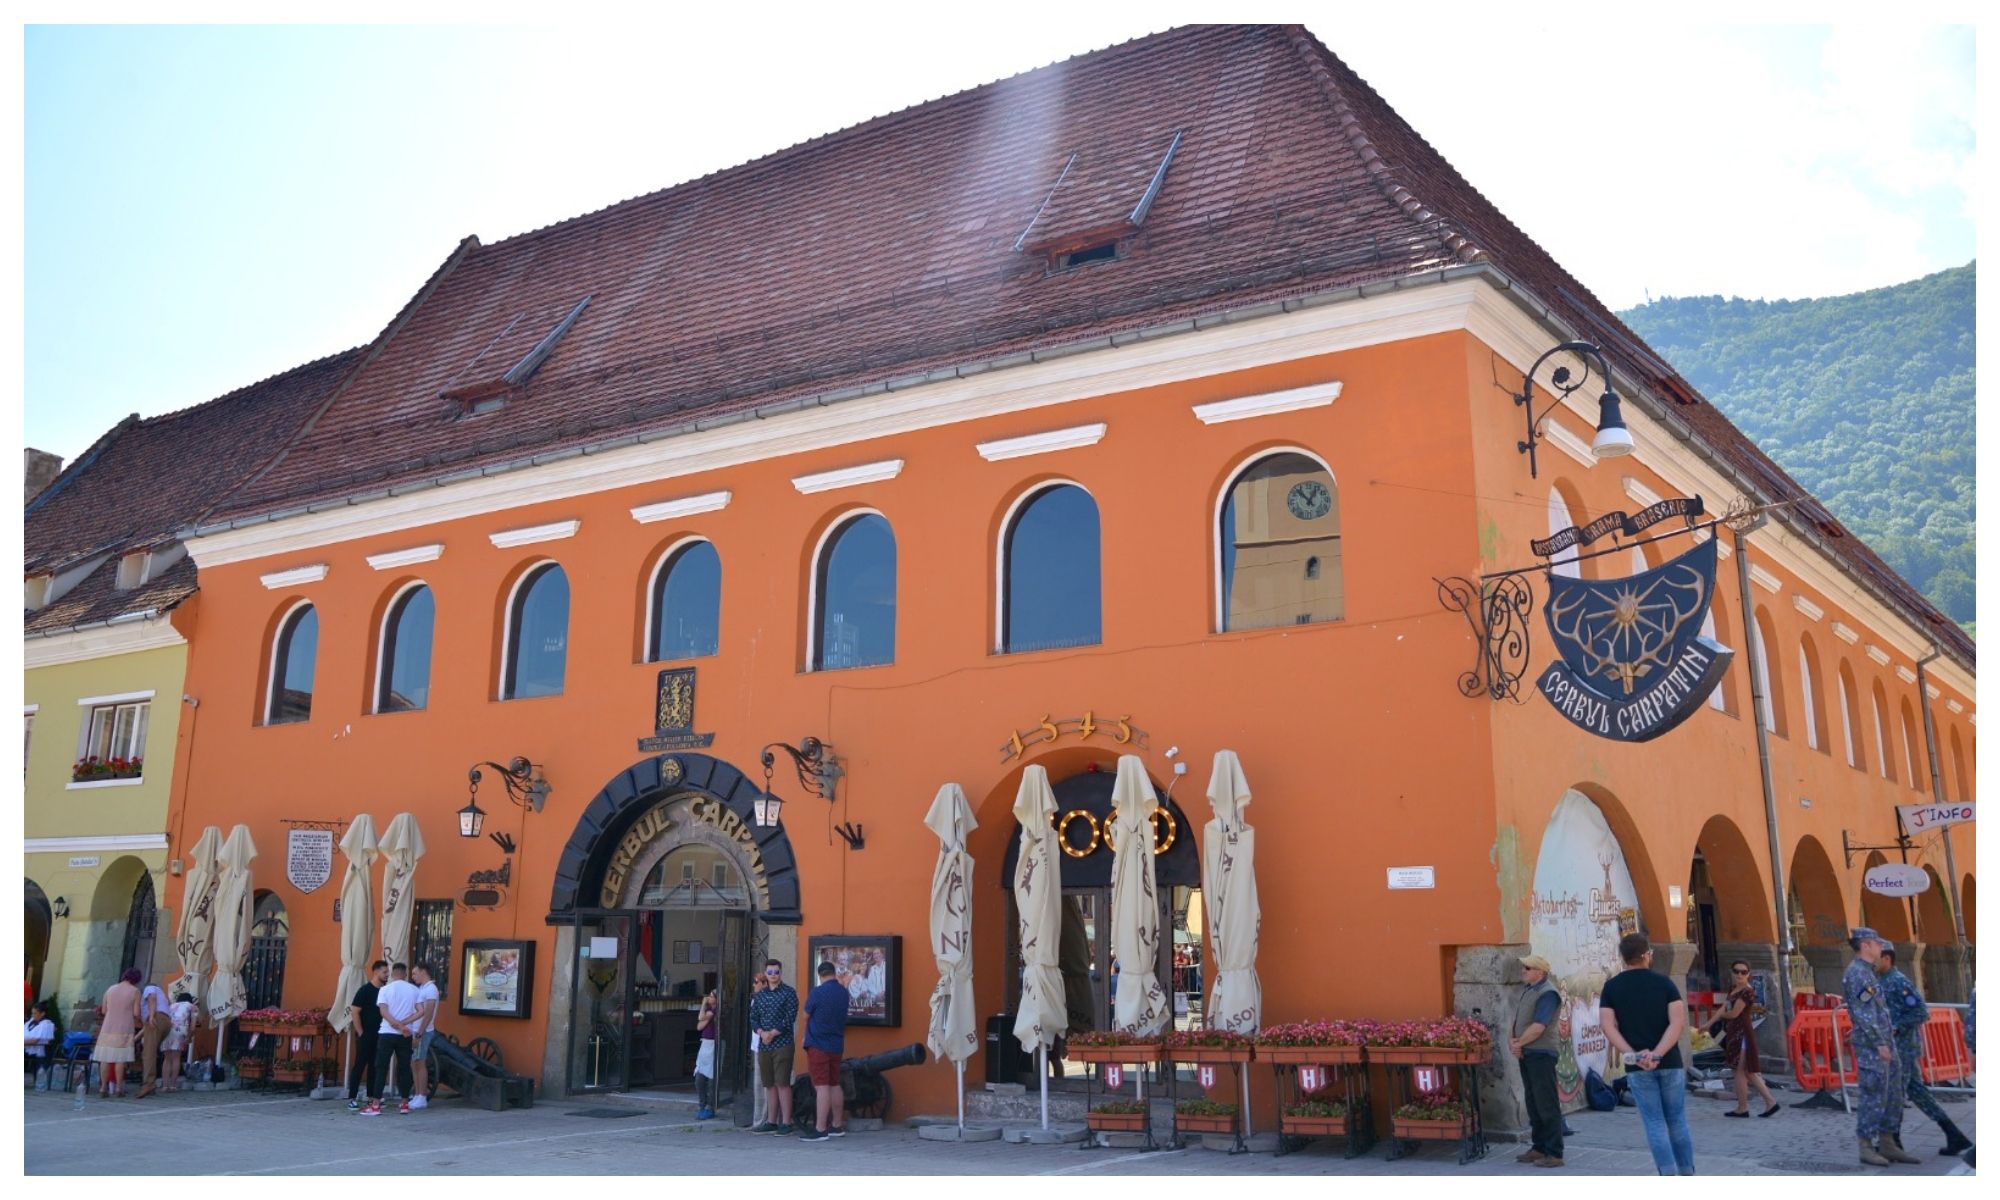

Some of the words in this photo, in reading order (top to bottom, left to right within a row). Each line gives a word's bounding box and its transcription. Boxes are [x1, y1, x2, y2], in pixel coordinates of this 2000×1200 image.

[1584, 513, 1622, 539] CRAMA
[1634, 499, 1687, 529] BRASERIE
[1616, 645, 1709, 737] CARPATIN
[1009, 710, 1132, 760] 1545
[1912, 807, 1972, 827] J'INFO
[1050, 805, 1176, 858] OD
[600, 807, 671, 909] CERBUL
[1868, 877, 1904, 888] Perfect
[1108, 1066, 1120, 1086] H
[1201, 1066, 1213, 1086] H
[1302, 1069, 1316, 1089] H
[1418, 1070, 1432, 1091] H
